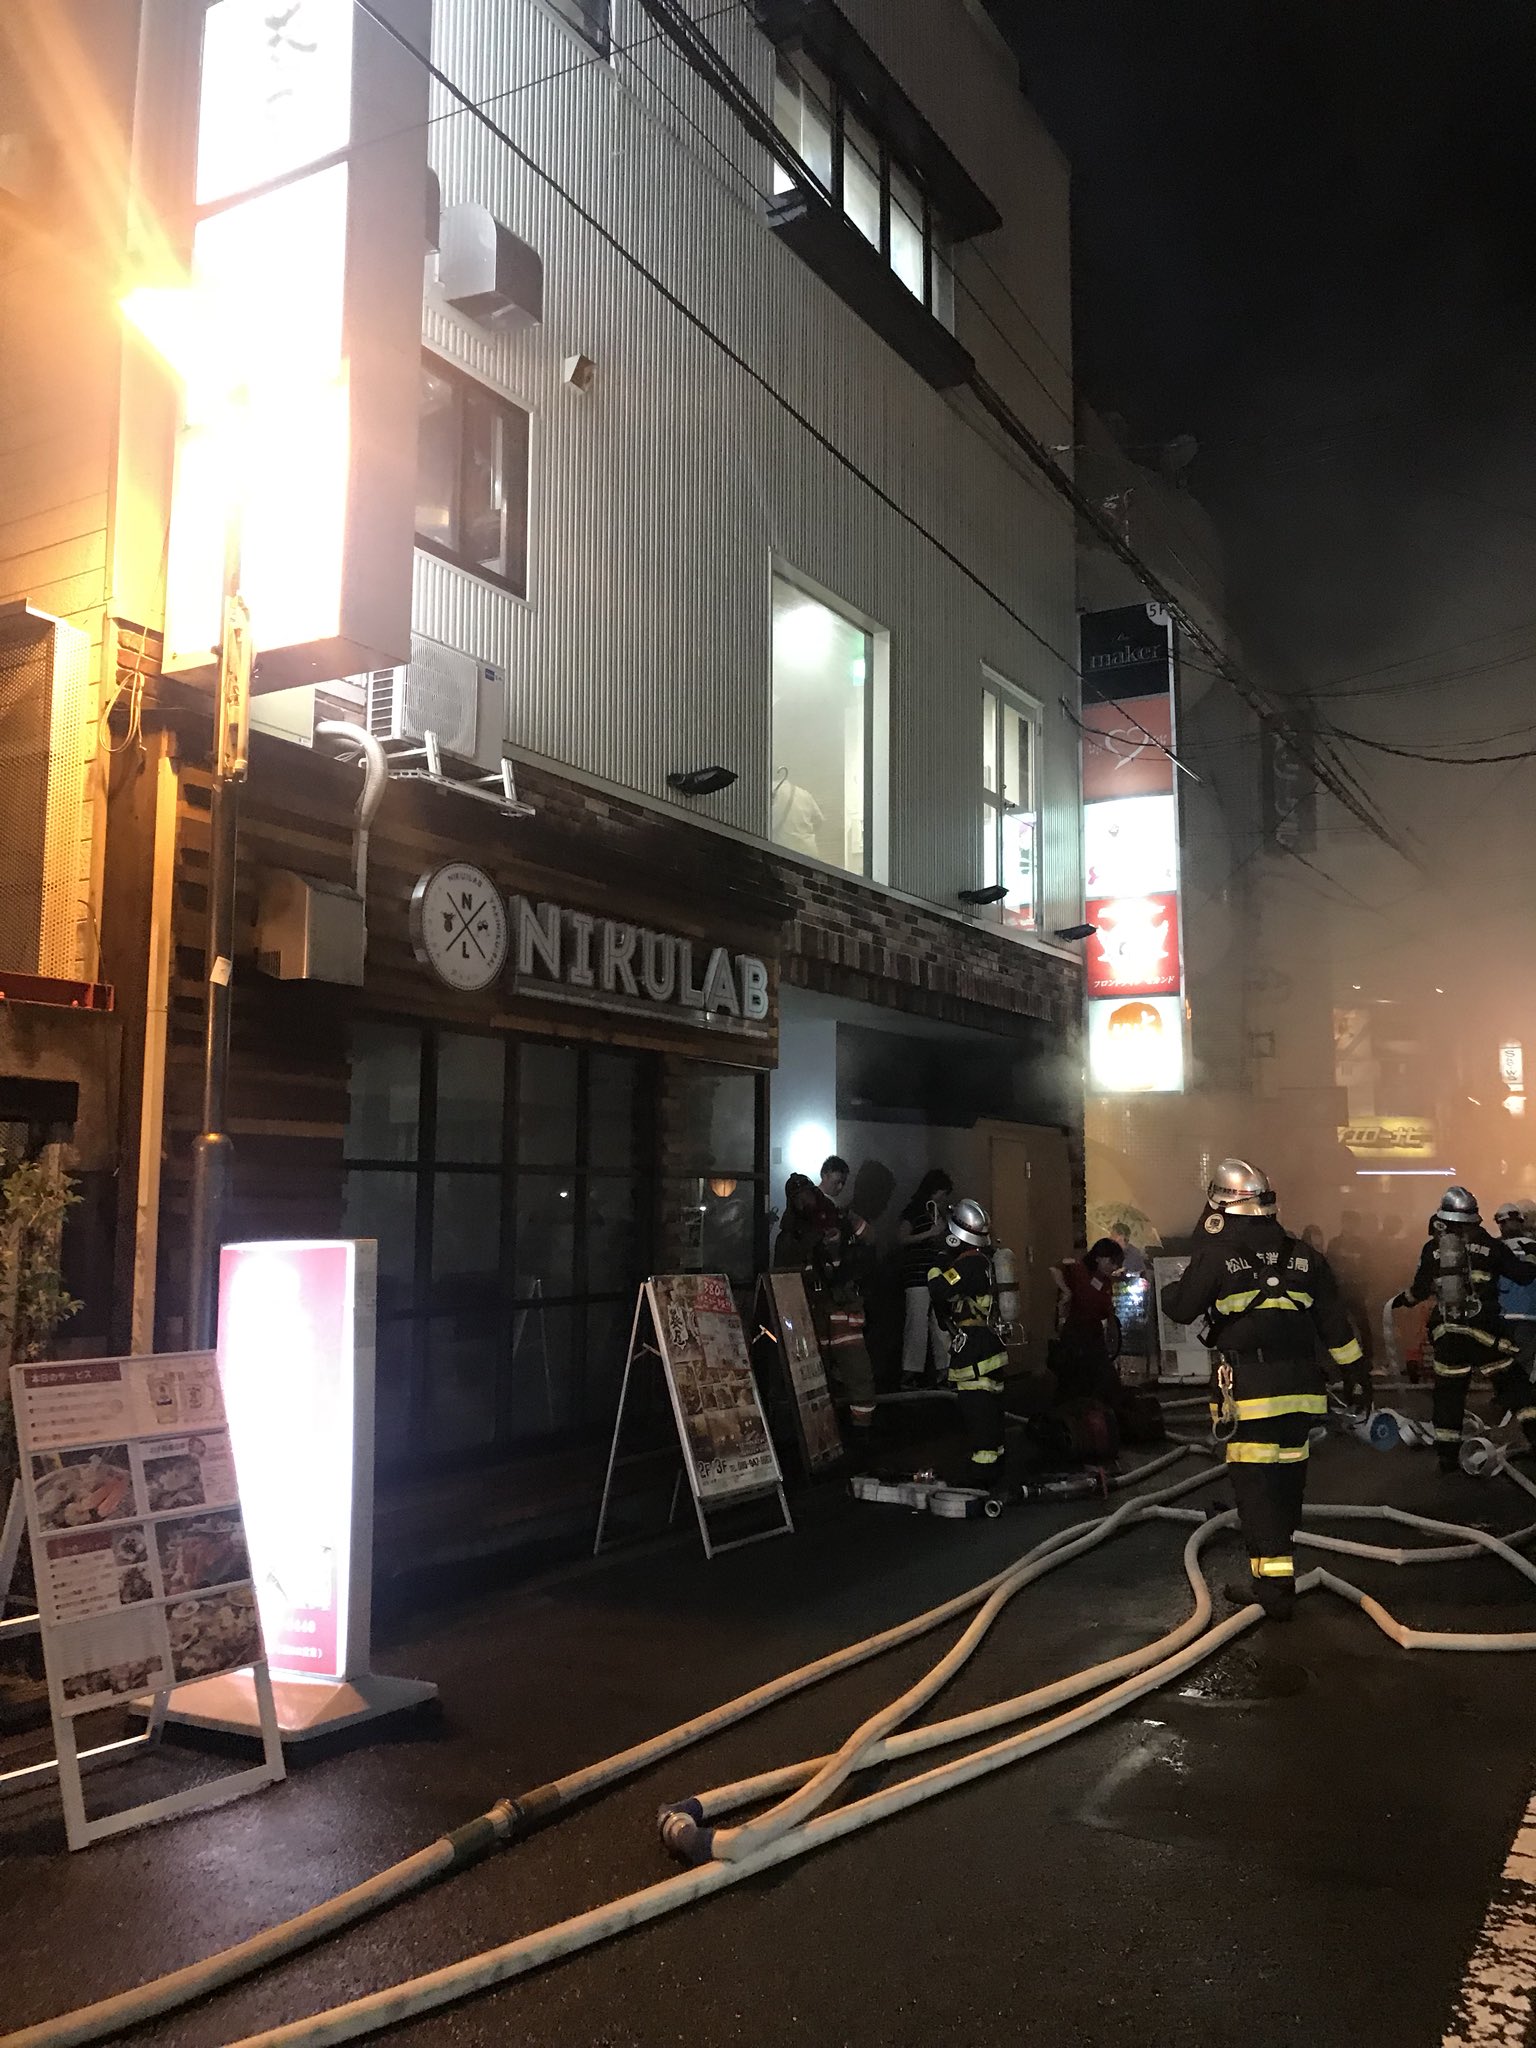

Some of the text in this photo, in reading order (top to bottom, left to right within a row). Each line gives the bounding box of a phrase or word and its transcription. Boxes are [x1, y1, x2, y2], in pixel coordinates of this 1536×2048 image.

[1090, 644, 1162, 669] maker
[461, 891, 473, 911] N
[462, 941, 470, 959] L
[511, 894, 770, 1020] NIKULAB
